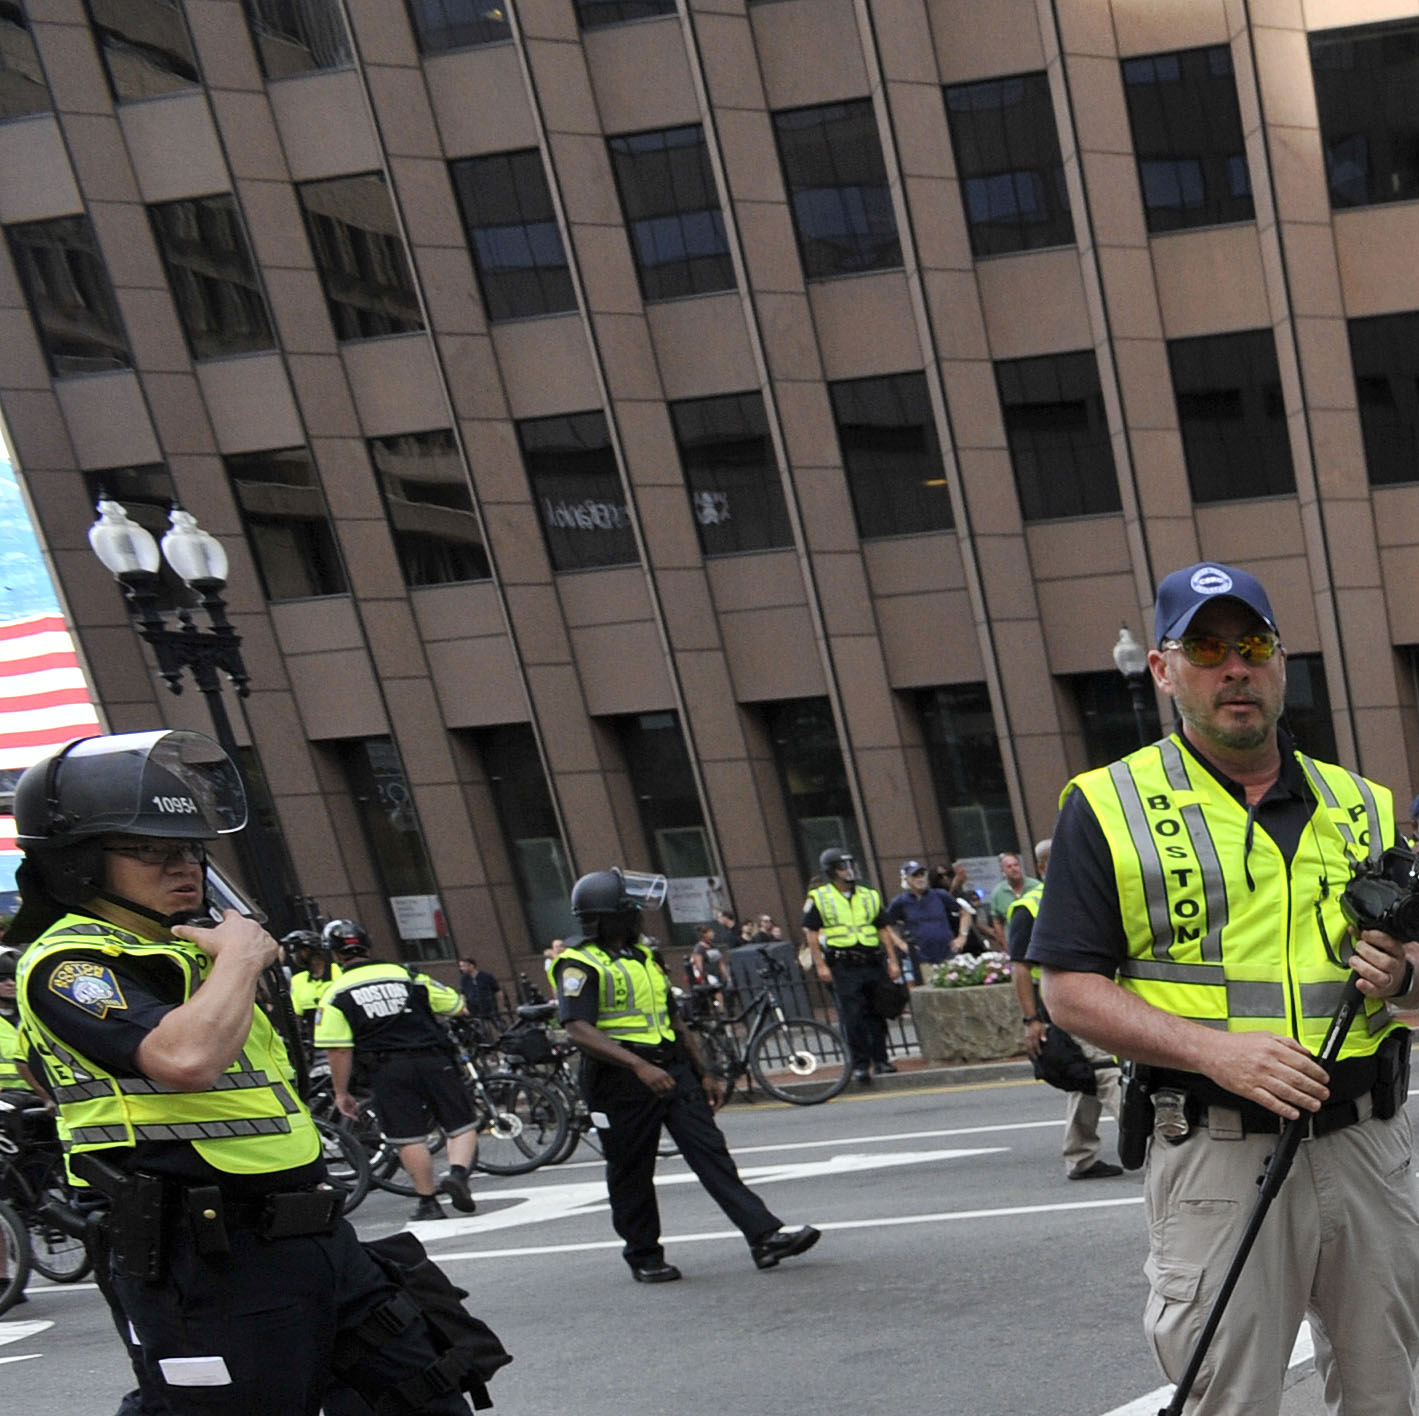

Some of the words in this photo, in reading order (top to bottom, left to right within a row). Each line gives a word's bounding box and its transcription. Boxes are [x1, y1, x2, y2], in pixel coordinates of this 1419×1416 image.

[152, 795, 198, 813] 10954
[1147, 794, 1201, 944] BOSTON
[350, 983, 409, 1006] BOSTON
[362, 998, 412, 1019] POLICE
